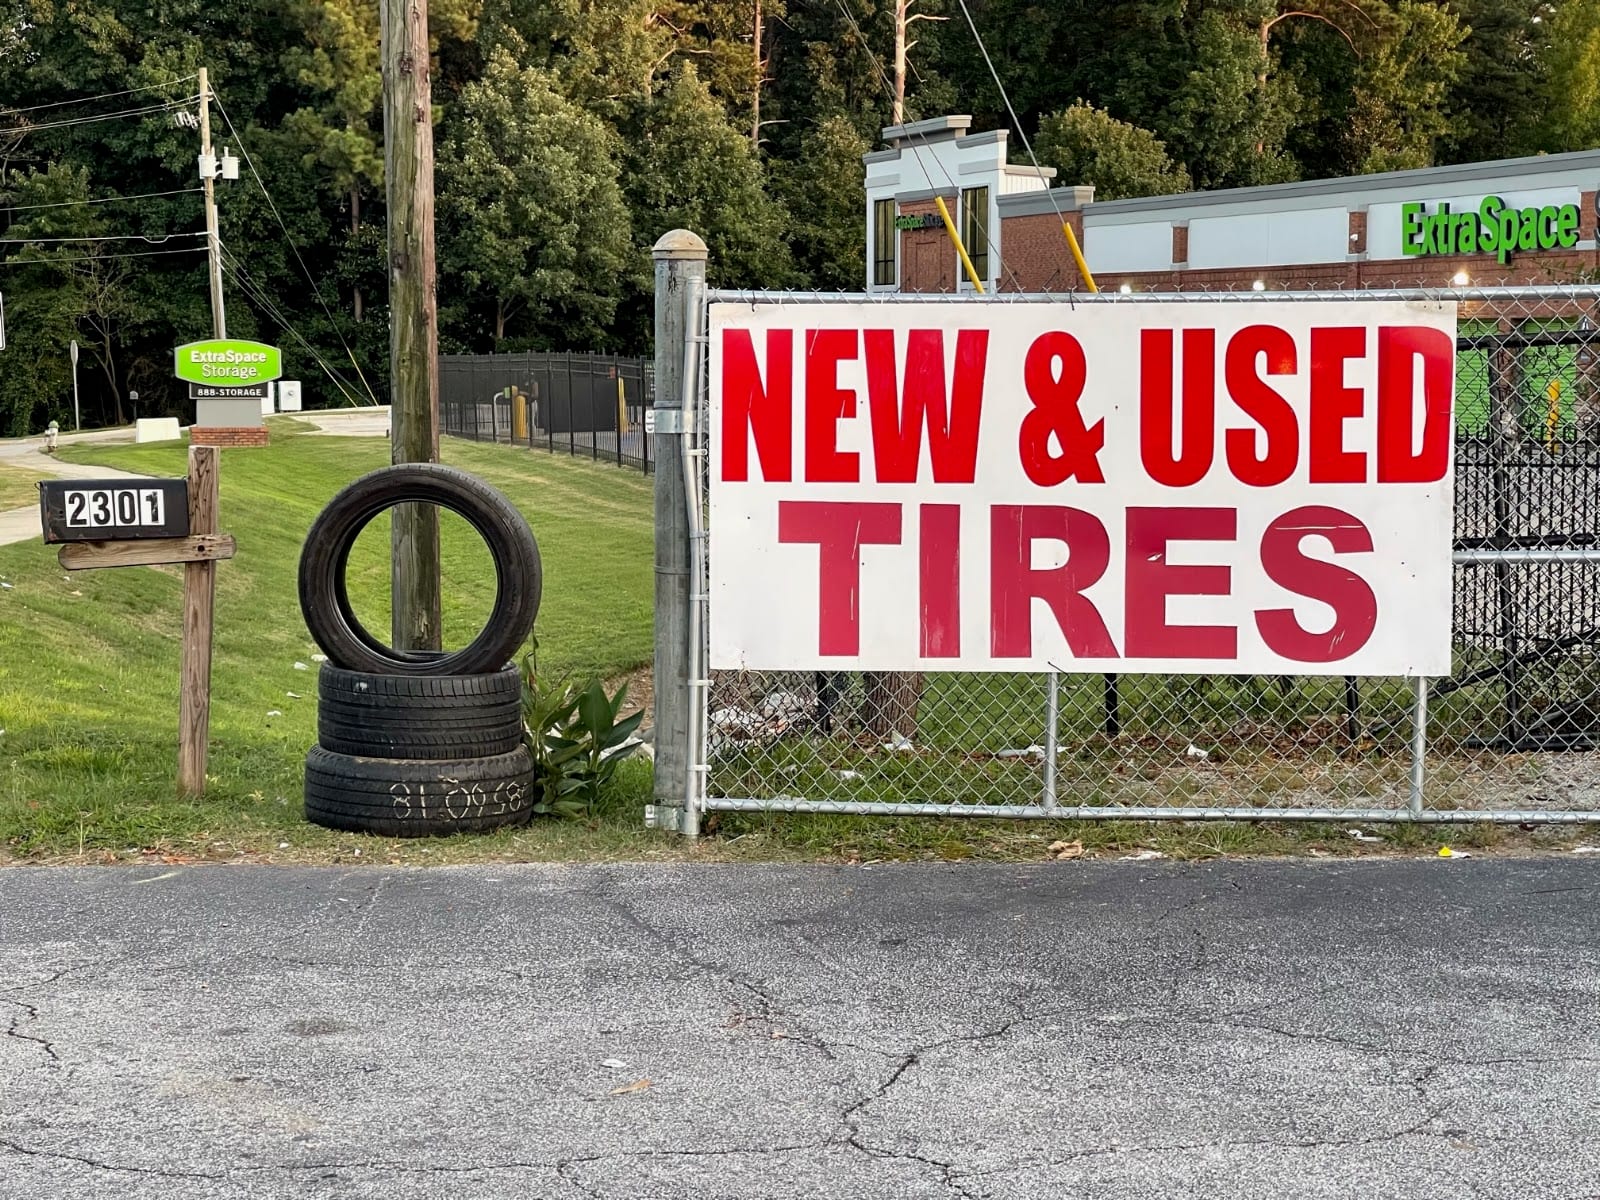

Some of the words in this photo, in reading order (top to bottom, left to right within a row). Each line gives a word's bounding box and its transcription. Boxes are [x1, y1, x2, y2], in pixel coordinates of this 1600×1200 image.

[1402, 195, 1580, 264] ExtraSpace
[191, 350, 267, 364] ExtraSpace
[202, 364, 257, 379] Storage
[197, 388, 262, 396] 888-STORAGE
[721, 328, 989, 483] NEW
[1018, 331, 1106, 487] &
[1140, 324, 1454, 487] USED
[68, 490, 160, 526] 2301
[778, 501, 1378, 663] TIRES
